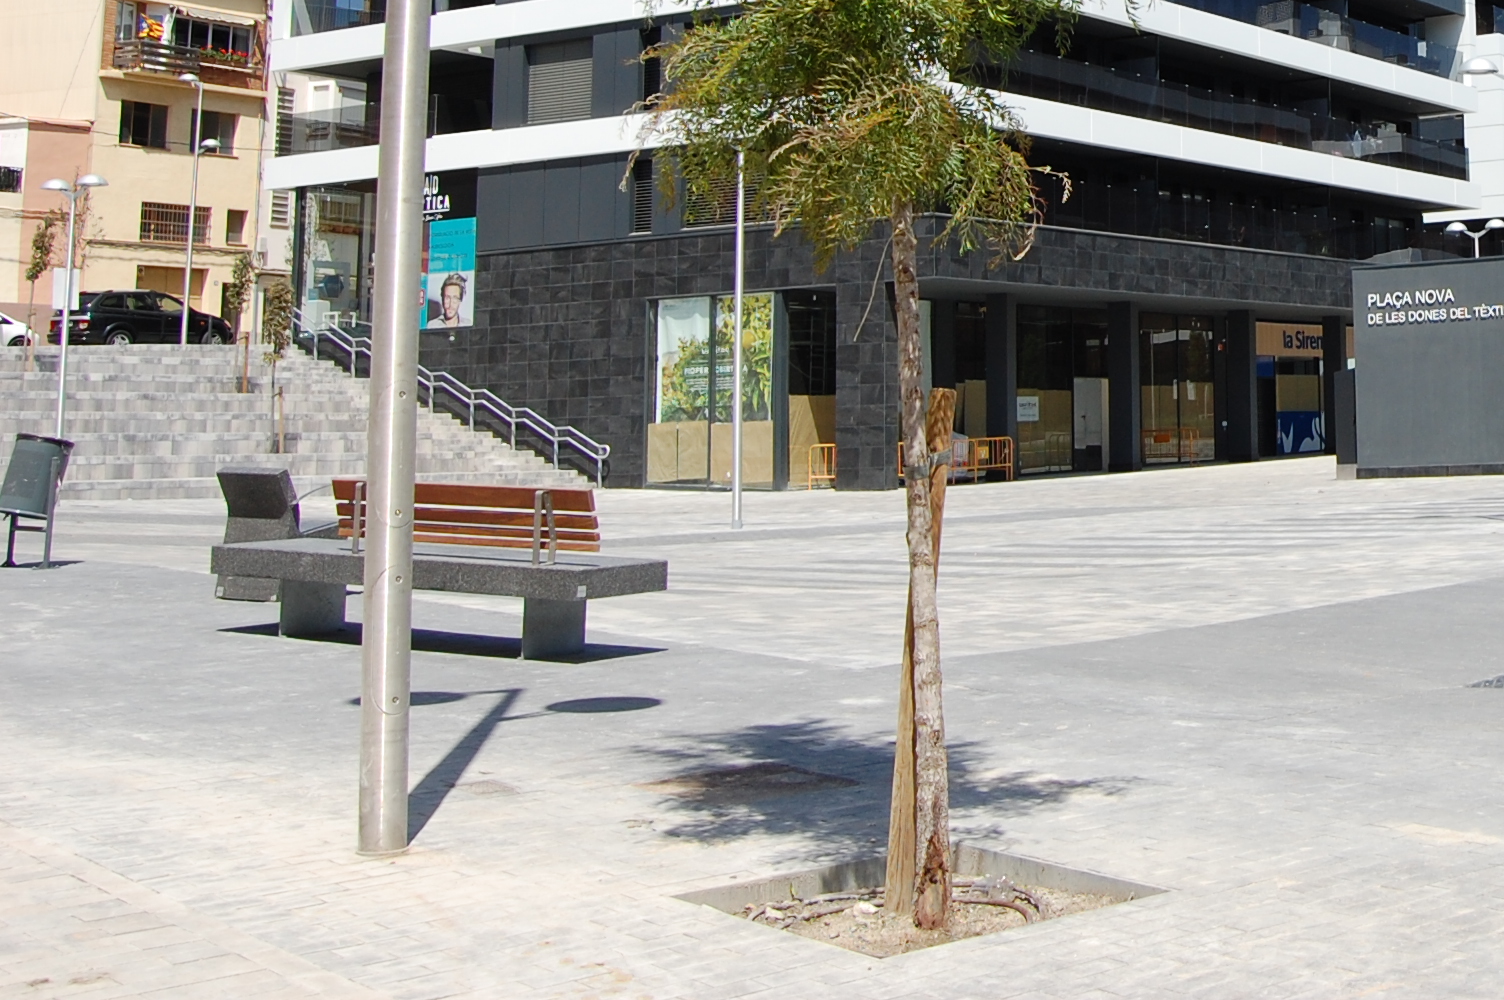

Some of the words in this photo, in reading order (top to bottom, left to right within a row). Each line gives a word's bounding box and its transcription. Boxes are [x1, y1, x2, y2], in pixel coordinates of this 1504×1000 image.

[1367, 290, 1413, 309] PLAÇA
[1415, 288, 1455, 304] NOVA
[1367, 312, 1384, 325] DE
[1385, 311, 1406, 324] LES
[1408, 308, 1447, 321] DONES
[1450, 306, 1471, 319] DEL
[1282, 330, 1293, 349] la
[1295, 330, 1323, 350] Siren
